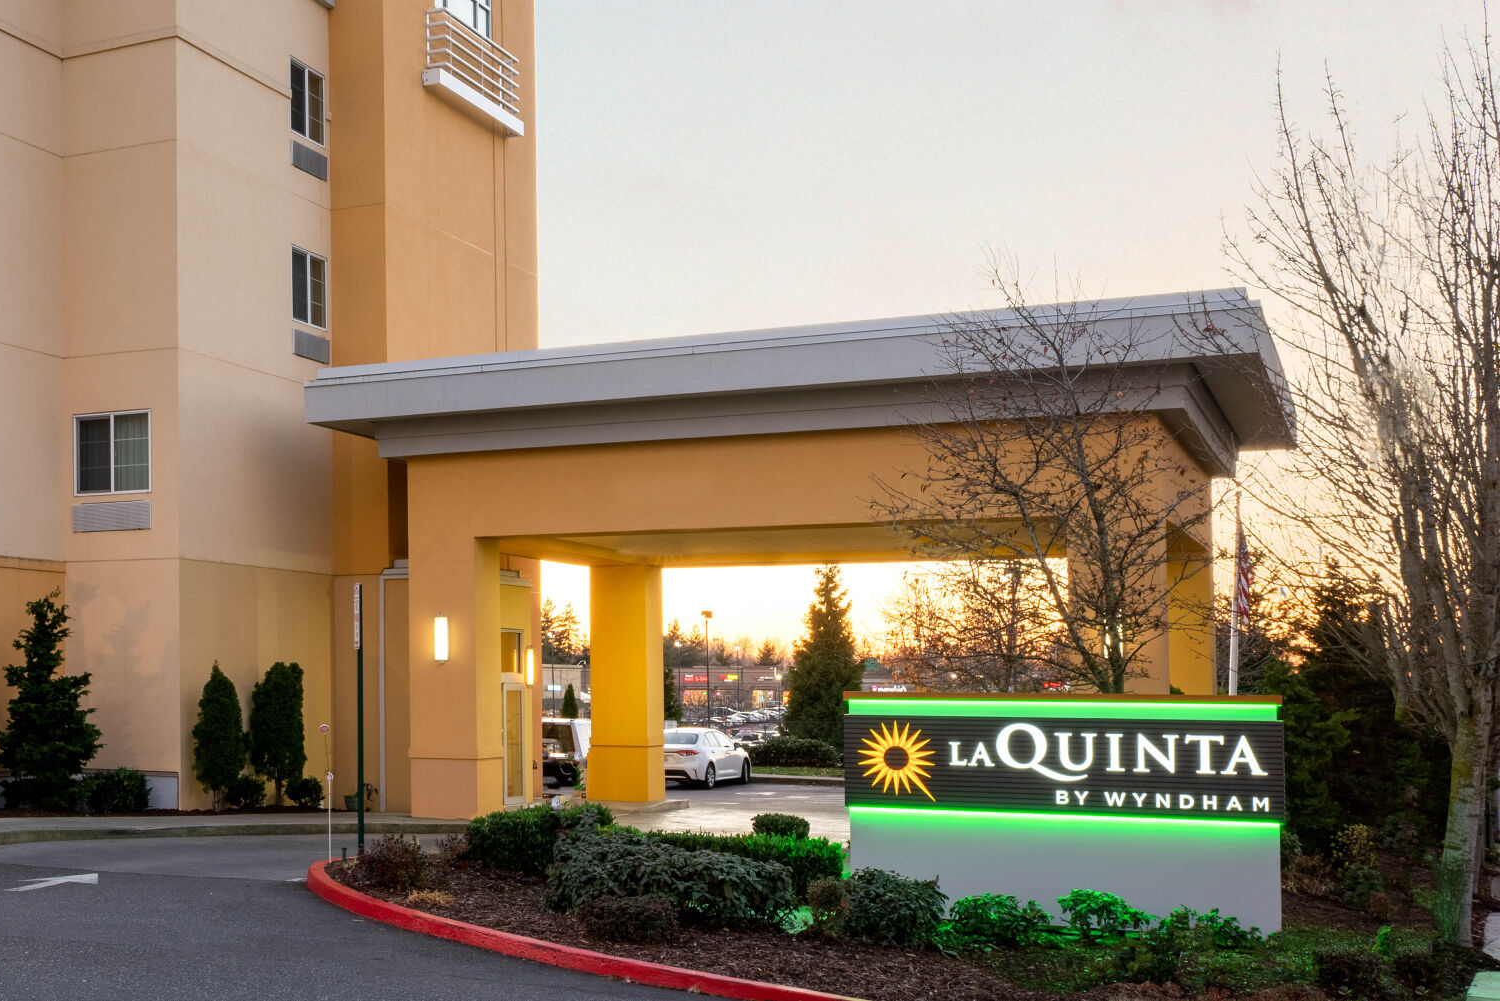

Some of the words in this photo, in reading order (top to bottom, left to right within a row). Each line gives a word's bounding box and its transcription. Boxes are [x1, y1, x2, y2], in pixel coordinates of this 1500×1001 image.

[949, 741, 995, 767] LA
[996, 722, 1268, 782] QUINTA
[1056, 790, 1088, 806] BY
[1105, 792, 1270, 812] WYNDHAM
